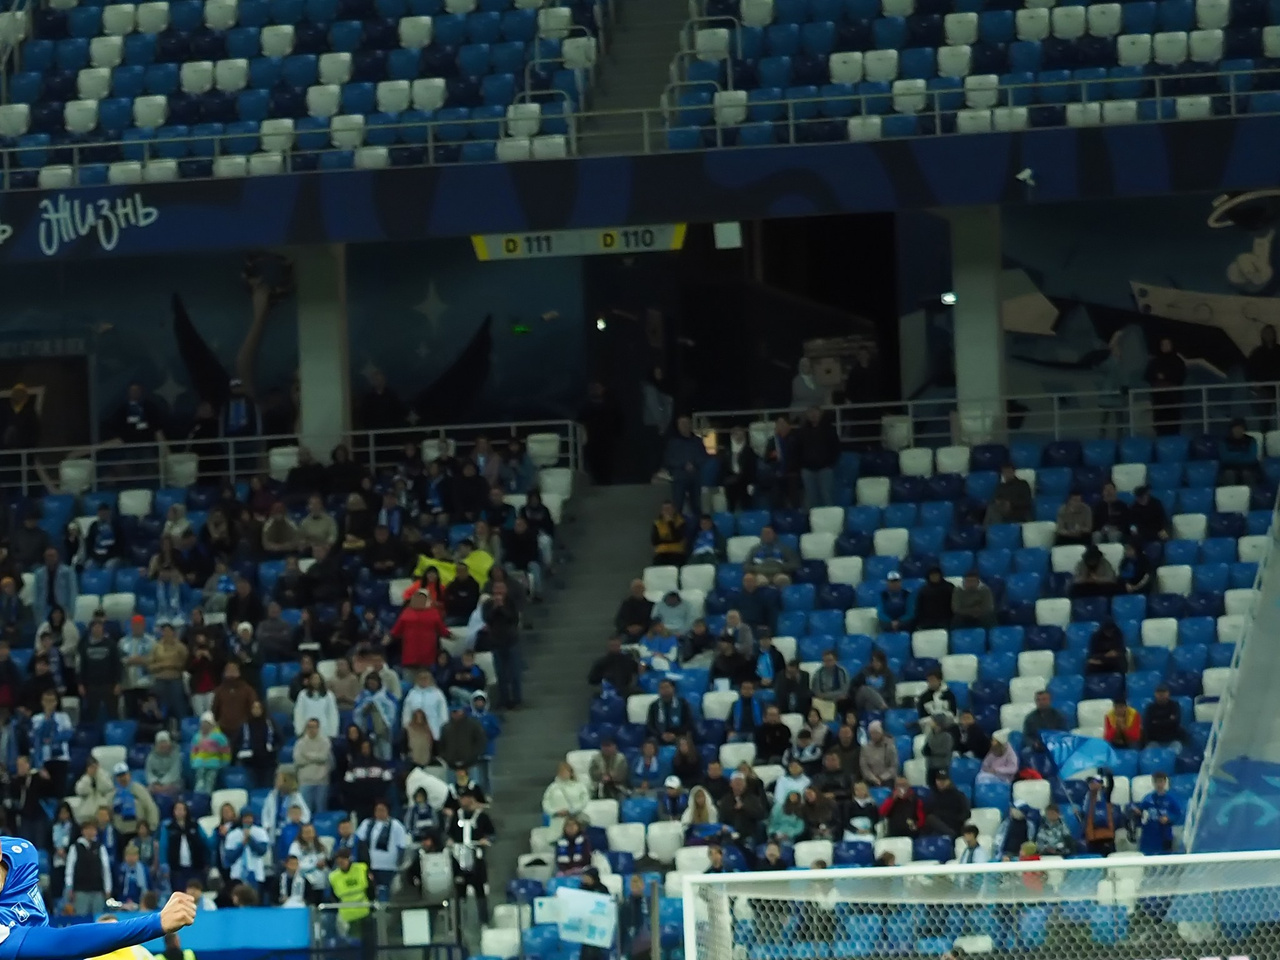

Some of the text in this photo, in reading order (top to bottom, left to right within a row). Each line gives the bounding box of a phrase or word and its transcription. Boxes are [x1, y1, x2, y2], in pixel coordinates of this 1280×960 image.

[505, 229, 654, 254] D 111 D 110
